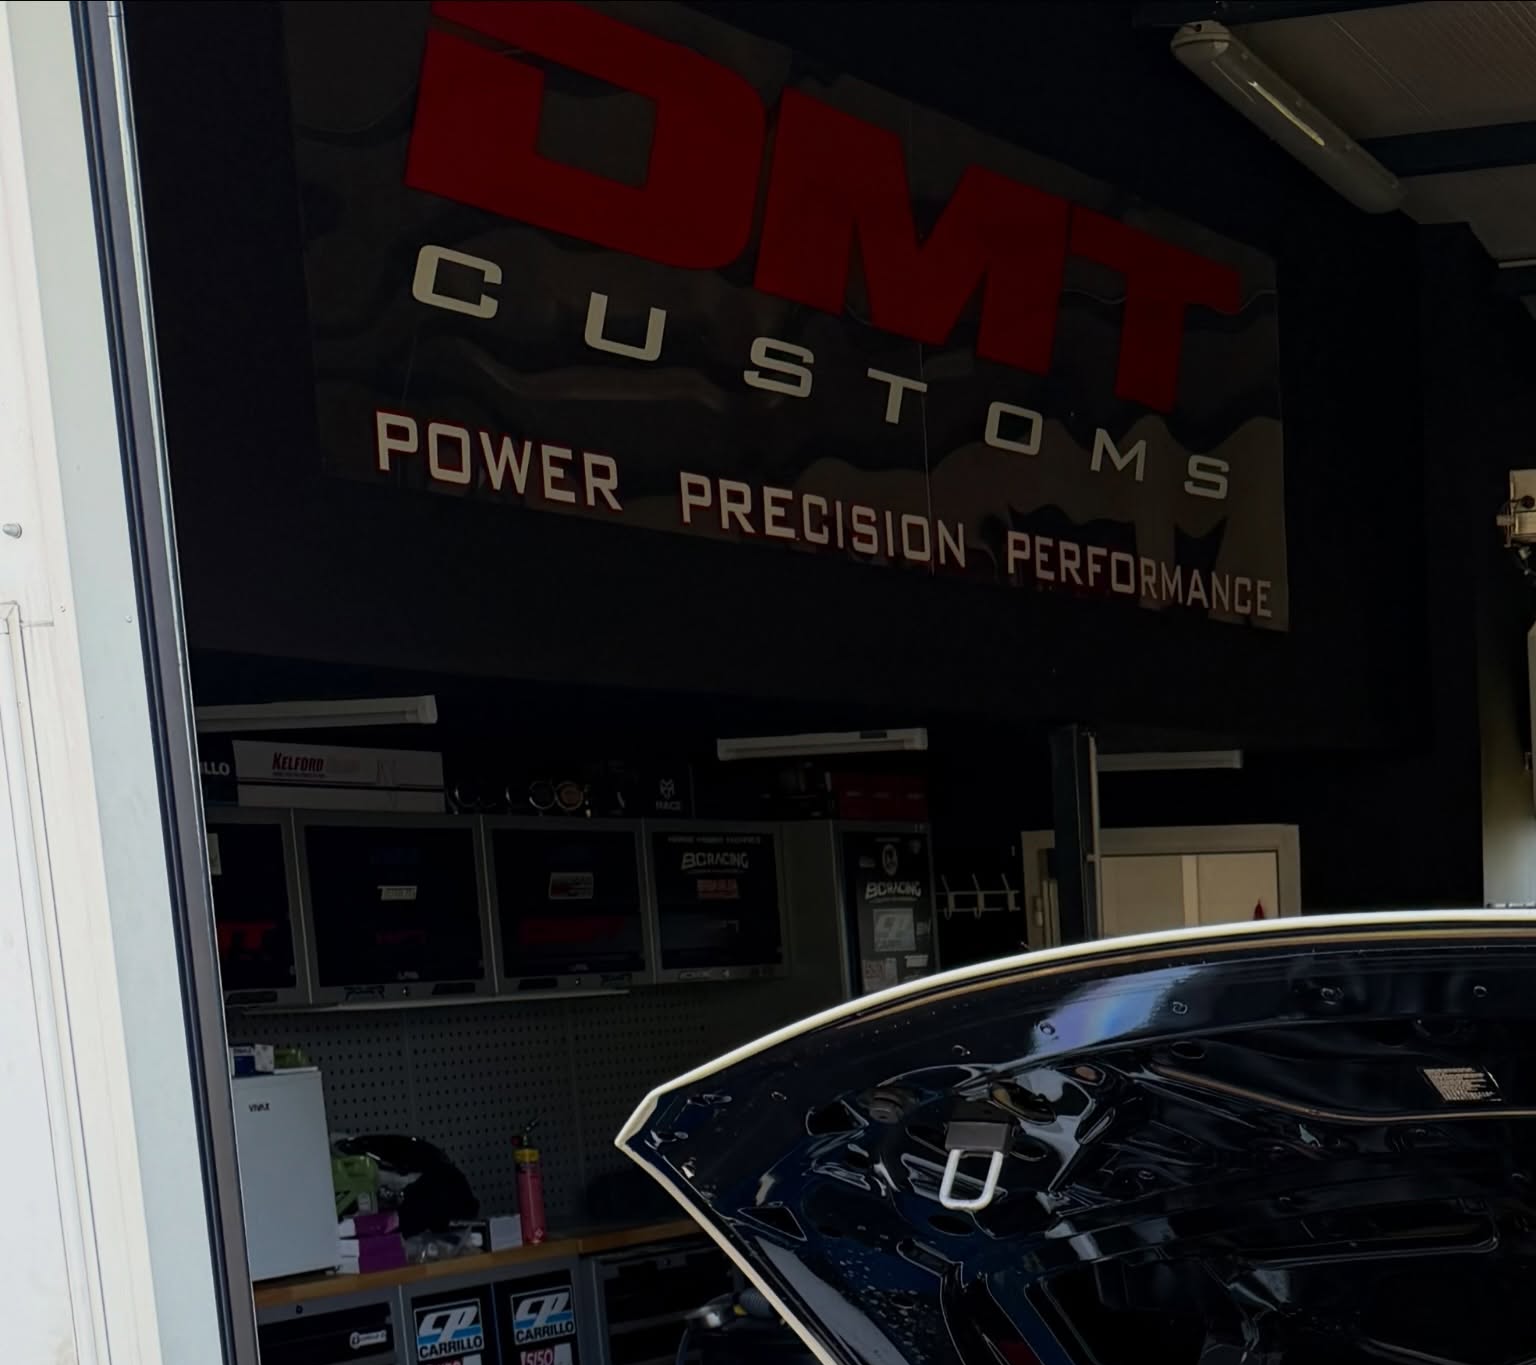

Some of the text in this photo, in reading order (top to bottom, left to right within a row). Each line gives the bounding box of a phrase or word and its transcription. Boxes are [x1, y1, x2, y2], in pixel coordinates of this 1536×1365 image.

[405, 0, 1243, 413] DMT
[412, 244, 1230, 501] CUSTOMS
[374, 410, 1274, 620] POWER PRECISION PERFORMANCE
[272, 752, 325, 772] KELFORD
[420, 1335, 483, 1359] CARRILLO
[516, 1321, 574, 1343] CARRILLO
